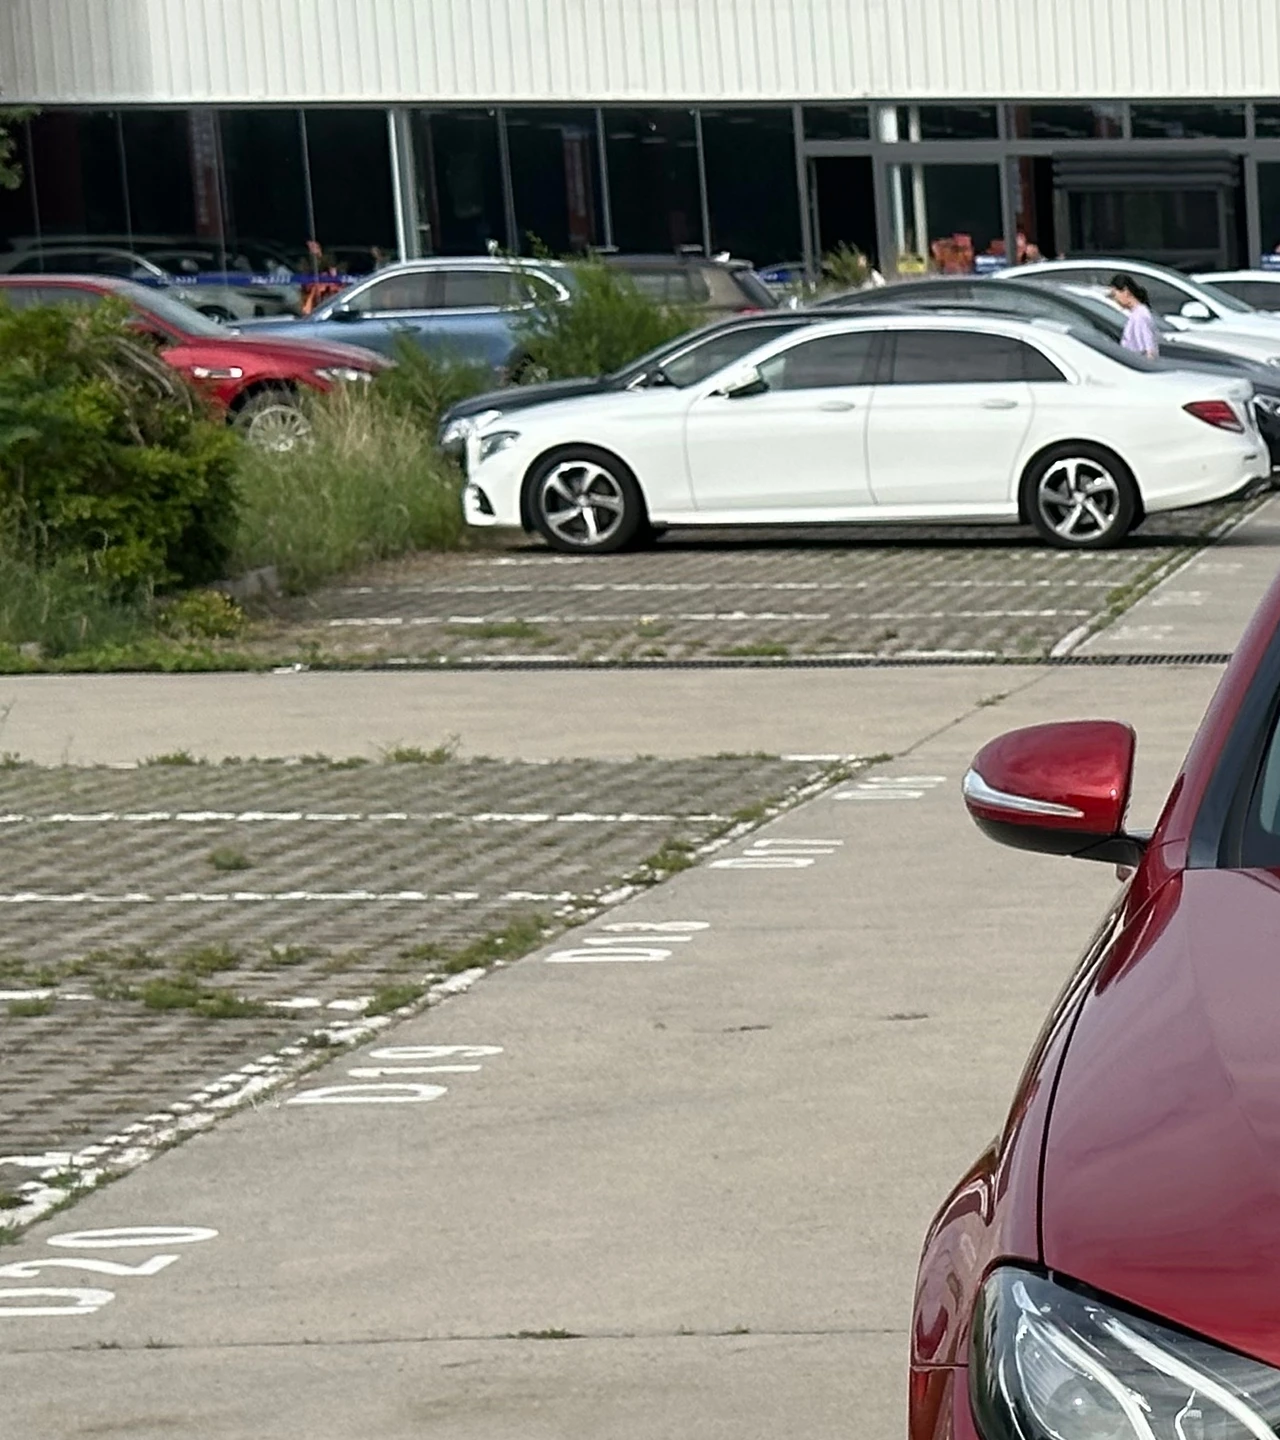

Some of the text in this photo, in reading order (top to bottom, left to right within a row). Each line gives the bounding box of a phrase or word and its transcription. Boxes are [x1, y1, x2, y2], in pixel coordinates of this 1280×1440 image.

[709, 839, 844, 868] D17
[545, 921, 710, 962] D18
[287, 1045, 503, 1104] D19
[0, 1226, 219, 1316] D20
